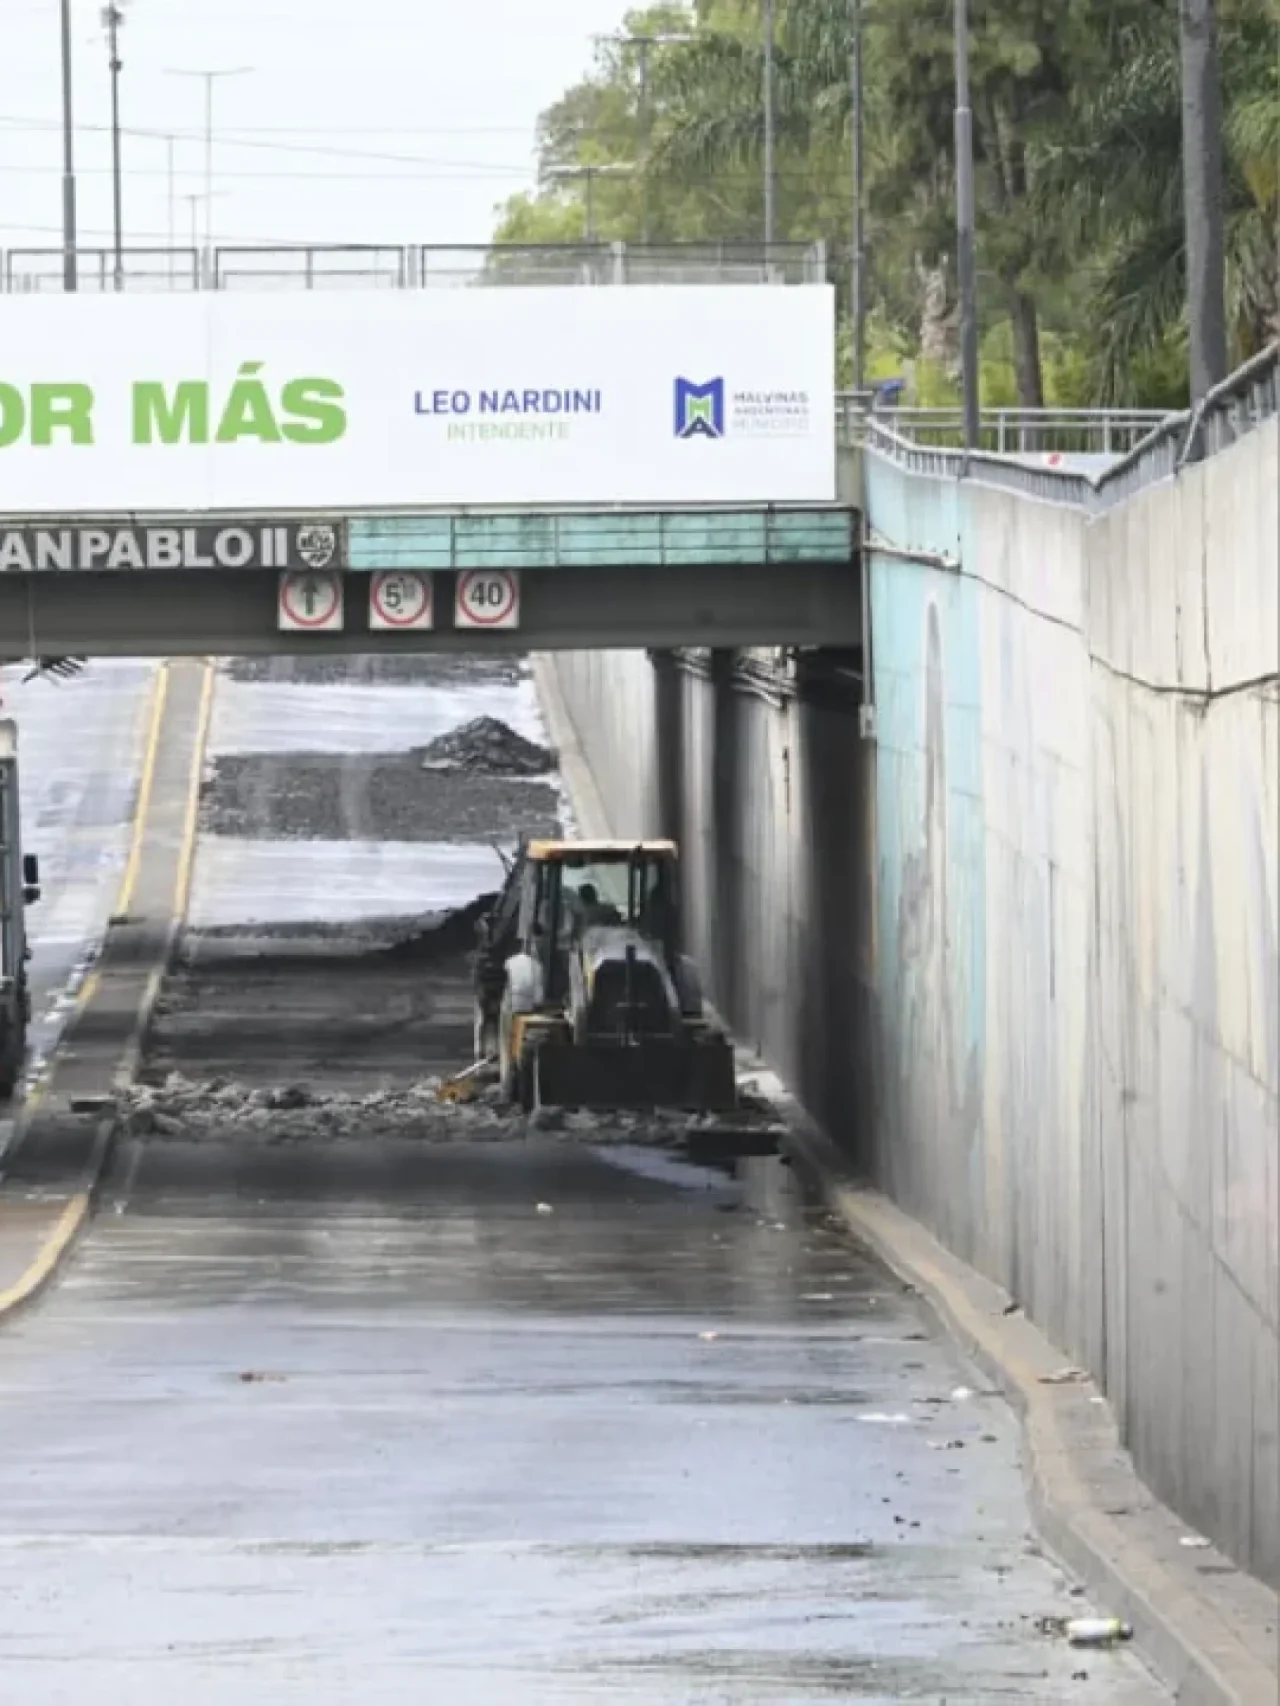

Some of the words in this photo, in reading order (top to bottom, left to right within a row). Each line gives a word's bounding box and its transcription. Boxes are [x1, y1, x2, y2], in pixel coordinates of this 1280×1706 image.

[131, 361, 347, 445] MÁS
[414, 389, 471, 415] LEO
[479, 388, 602, 413] NARDINI
[447, 421, 570, 441] INTENDENTE
[470, 581, 504, 607] 40
